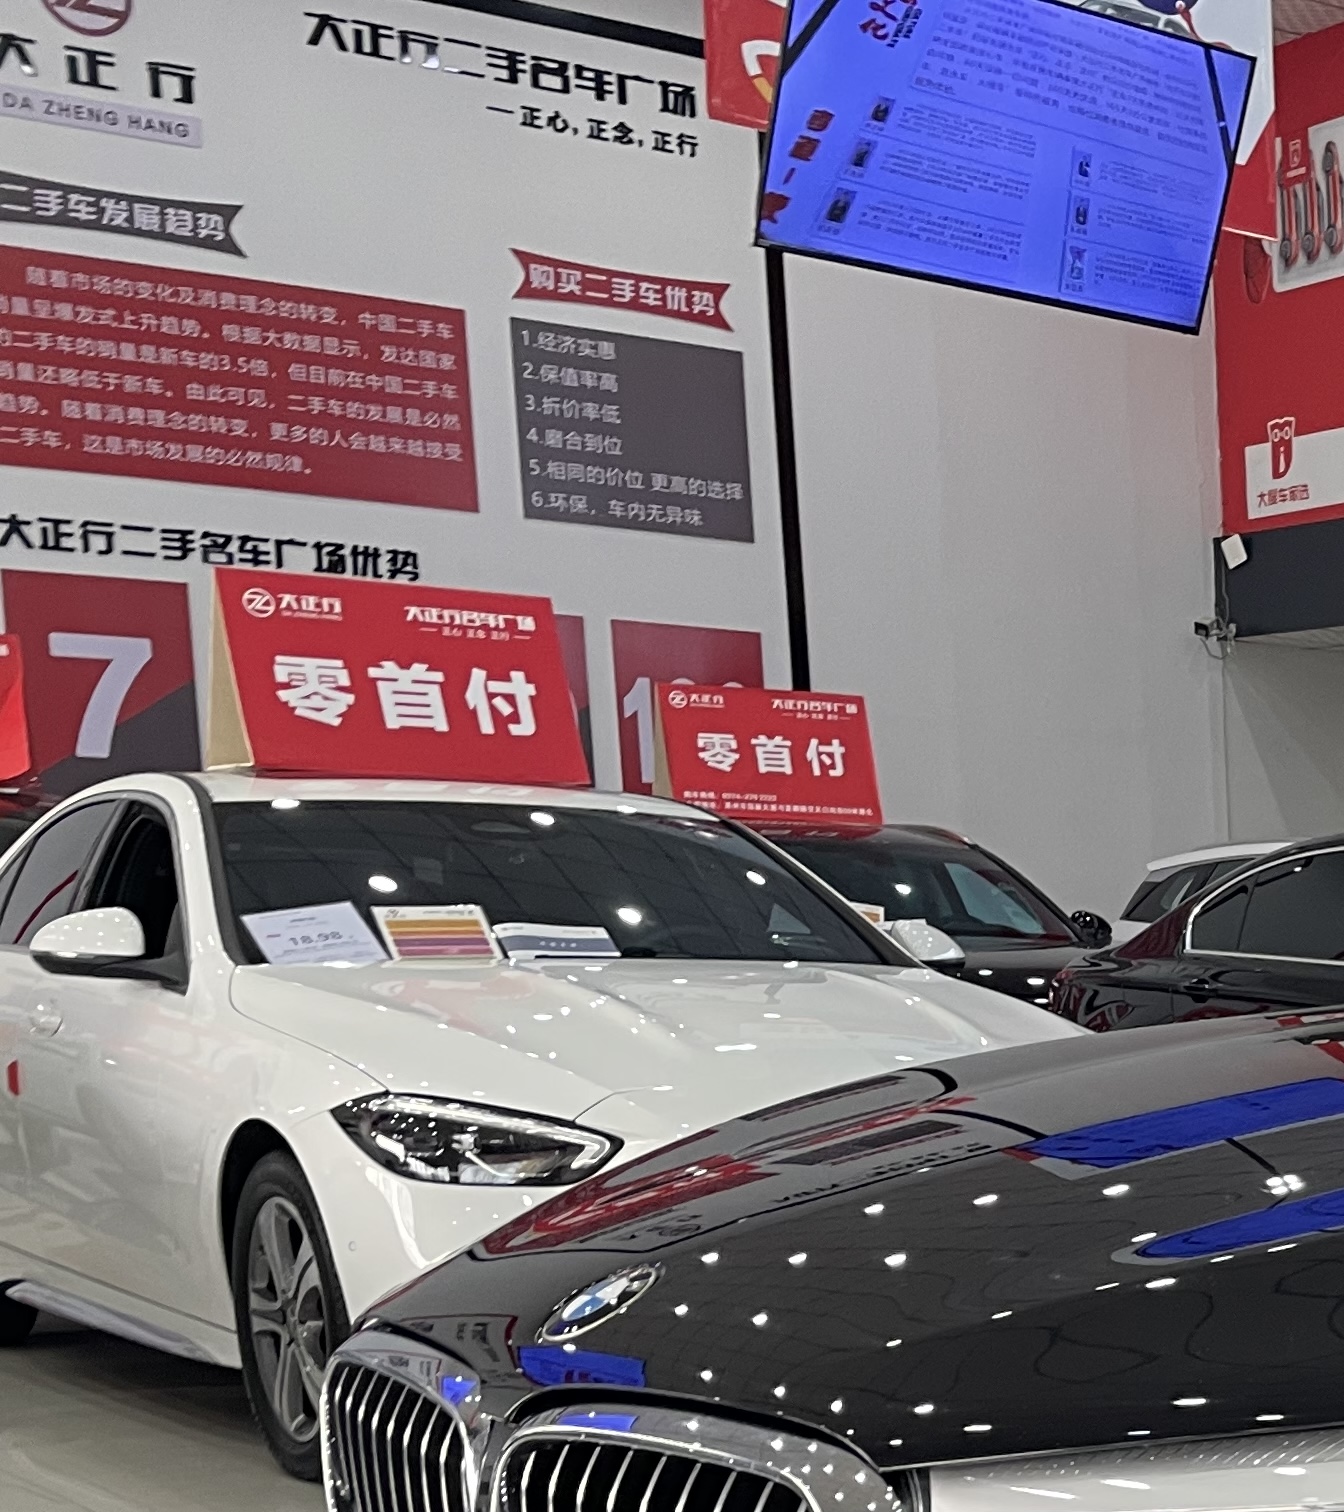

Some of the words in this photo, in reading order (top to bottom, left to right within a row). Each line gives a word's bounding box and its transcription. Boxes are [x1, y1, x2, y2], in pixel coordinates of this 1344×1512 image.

[0, 33, 196, 105] 大正行
[303, 11, 698, 119] 大正行二手名车广场
[2, 92, 34, 110] DA
[43, 99, 119, 126] ZHENG
[127, 114, 190, 138] HANG
[0, 183, 227, 242] 二手车发展趋势
[528, 263, 716, 316] 购买二手车优势
[0, 514, 419, 582] 大正行二手名车广场优势
[277, 593, 342, 614] 大正行
[48, 632, 152, 759] 7
[273, 654, 537, 736] 零首付
[697, 732, 846, 777] 零首付
